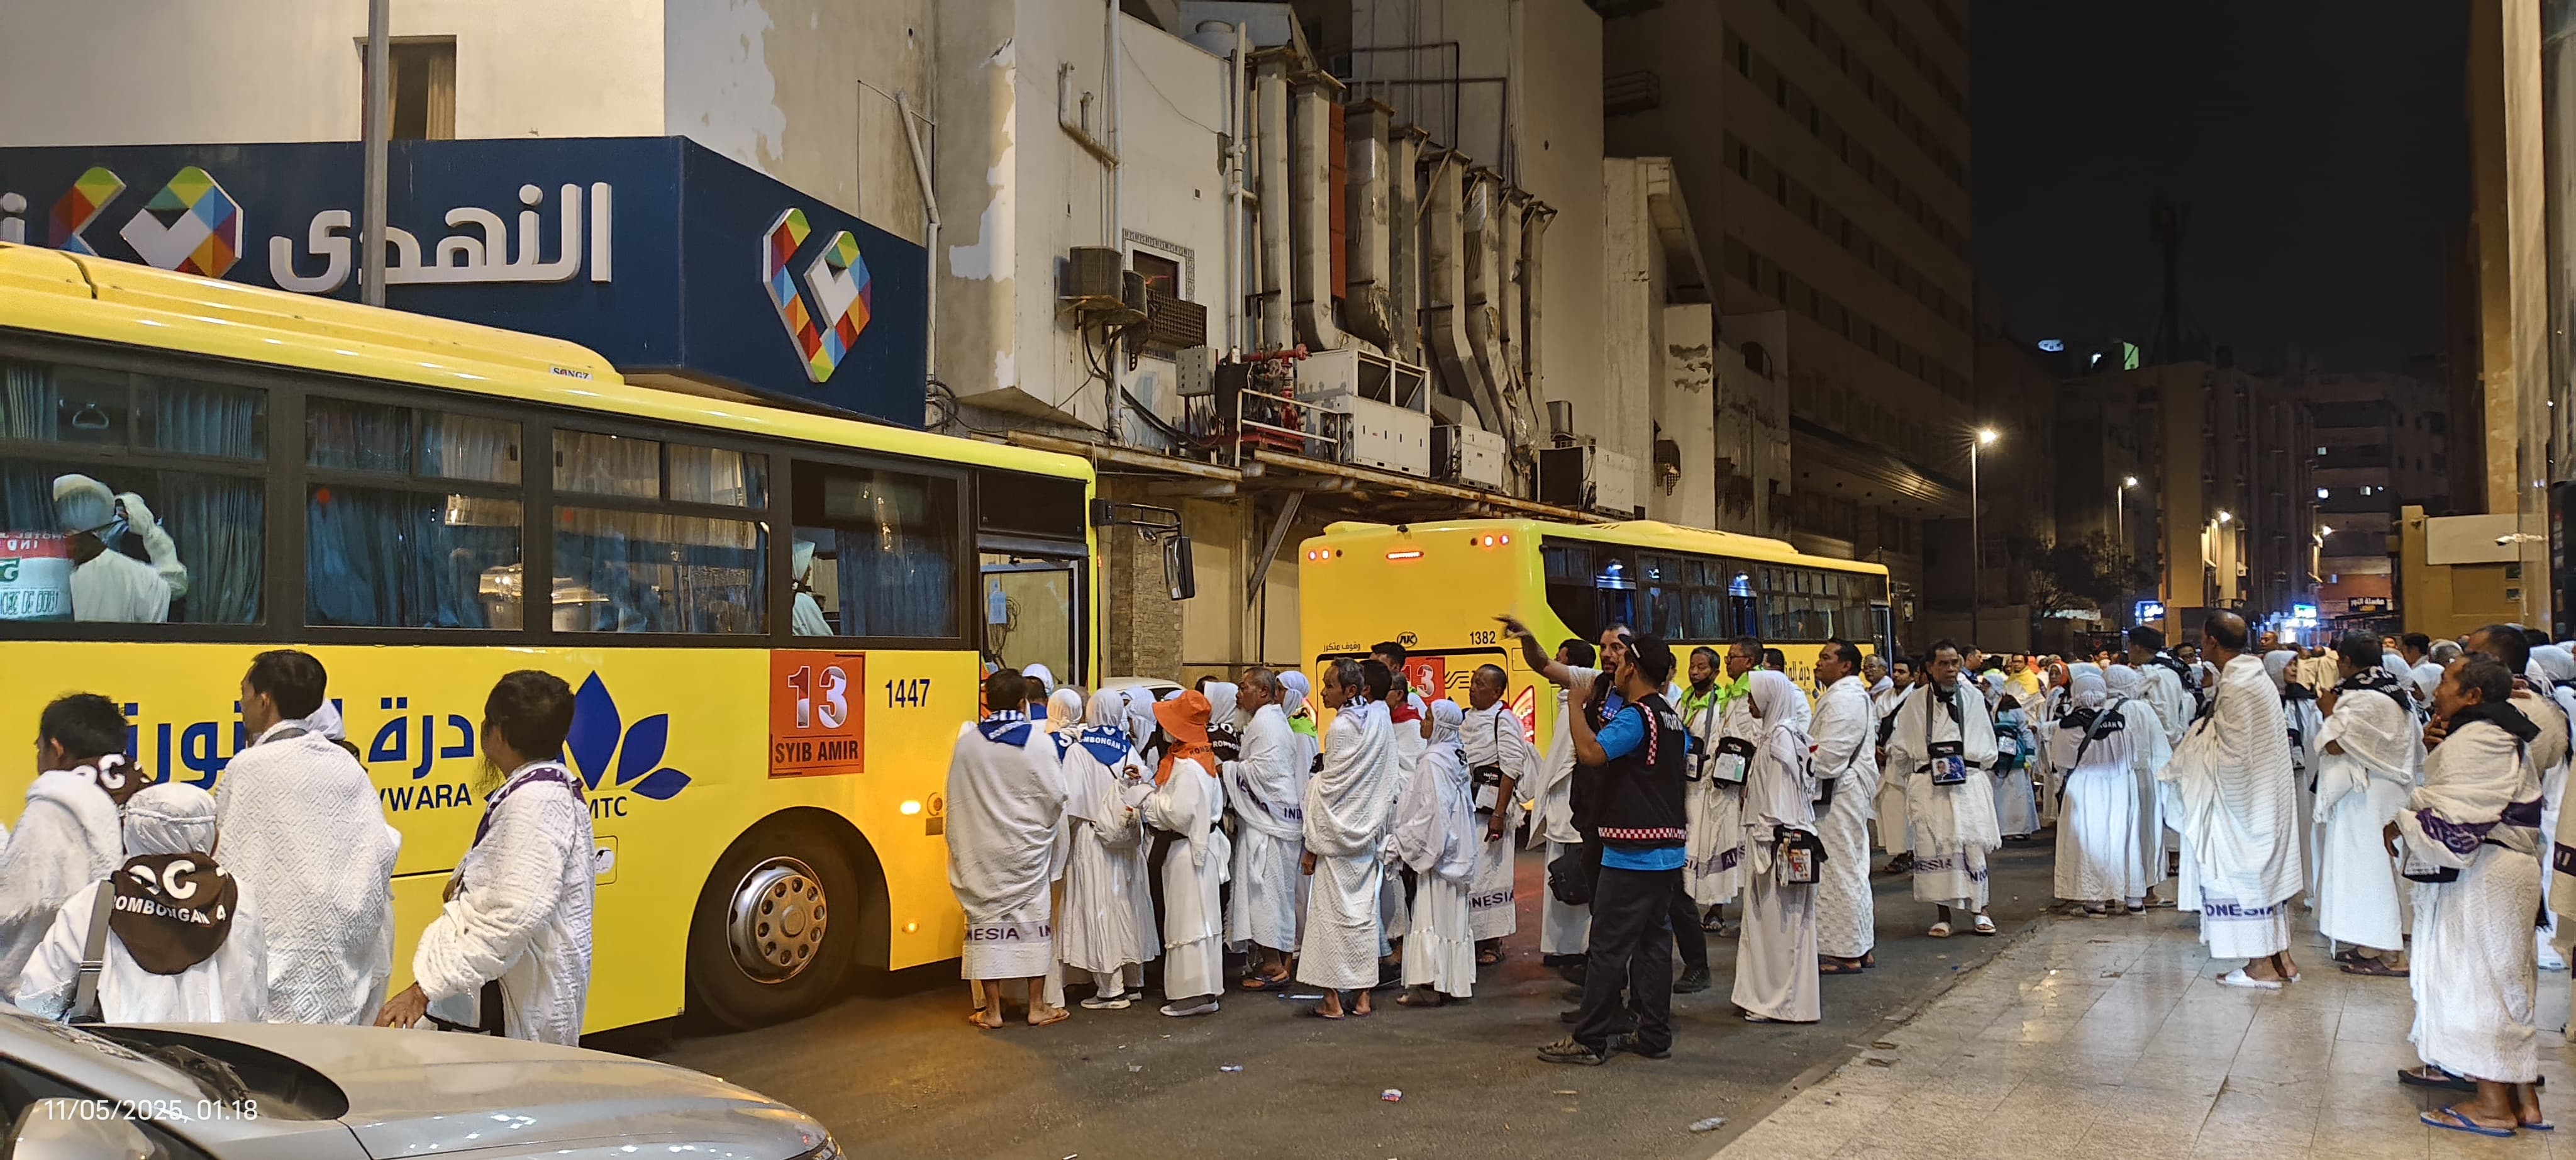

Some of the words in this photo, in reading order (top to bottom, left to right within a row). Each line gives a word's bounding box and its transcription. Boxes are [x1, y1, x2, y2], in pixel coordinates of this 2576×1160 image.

[1469, 630, 1496, 645] 1382
[787, 665, 848, 728] 13
[885, 678, 931, 709] 1447
[1401, 664, 1435, 698] 13
[368, 696, 475, 780] درة
[775, 742, 812, 764] SYIB
[817, 740, 858, 762] AMIR
[113, 895, 211, 925] OMBONGAN
